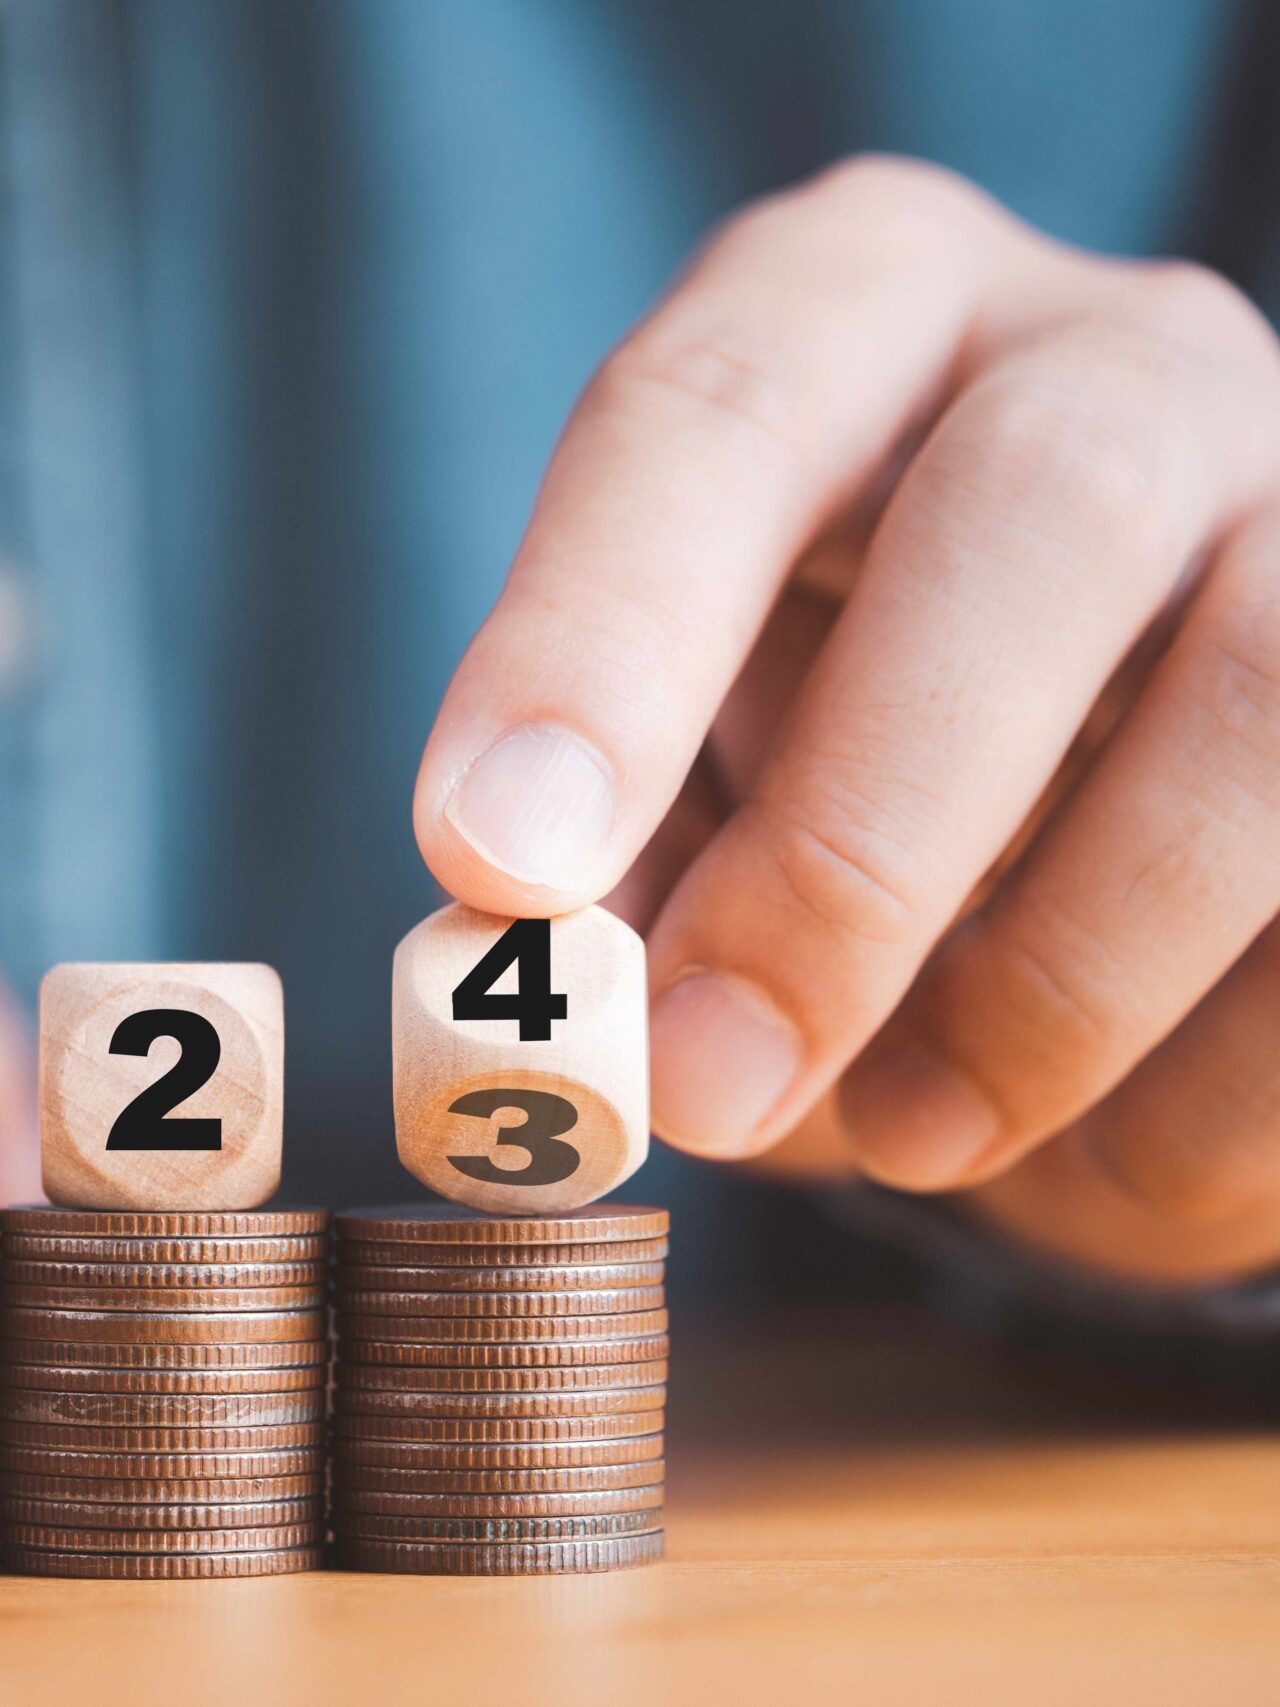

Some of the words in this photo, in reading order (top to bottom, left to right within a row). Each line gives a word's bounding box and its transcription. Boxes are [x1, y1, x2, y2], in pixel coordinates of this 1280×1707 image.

[452, 919, 567, 1042] 4
[106, 1009, 222, 1151] 2
[447, 1089, 580, 1186] 3
